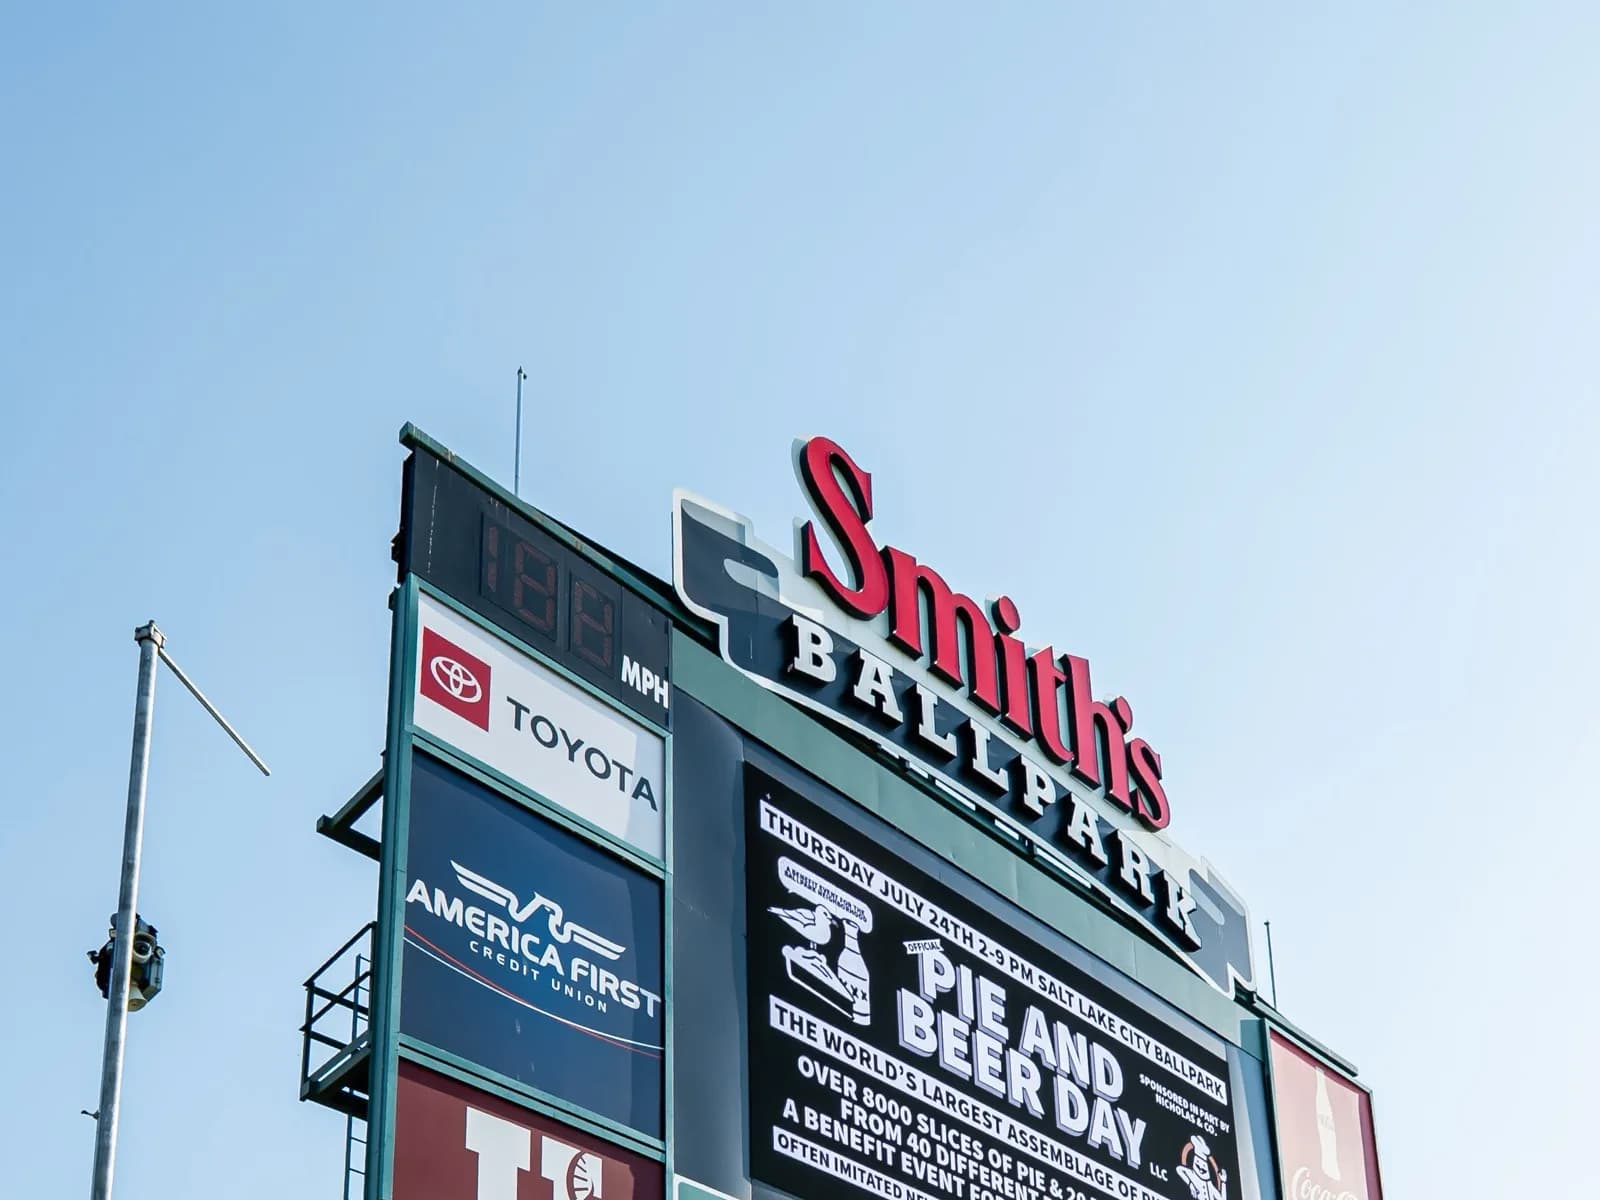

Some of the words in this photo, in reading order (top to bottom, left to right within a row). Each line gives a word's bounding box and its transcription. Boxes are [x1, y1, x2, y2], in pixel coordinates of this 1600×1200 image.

[621, 655, 669, 708] MPH
[800, 436, 1171, 832] Smith's
[506, 696, 657, 812] TOYOTA
[792, 613, 1201, 949] BALLPARK
[406, 879, 565, 976] AMERICA
[571, 957, 662, 1017] FIRST
[469, 940, 540, 981] CREDIT
[551, 978, 607, 1013] UNION
[765, 808, 874, 887] THURSDAY
[880, 879, 923, 917] JULY
[929, 909, 974, 948] 24TH
[978, 939, 1004, 965] 2-9
[1010, 957, 1034, 985] PM
[1038, 977, 1075, 1008] SALT
[1079, 999, 1116, 1034] LAKE
[1120, 1022, 1151, 1053] CITY
[1155, 1042, 1225, 1098] BALLPARK
[908, 942, 940, 952] OFFICIAL
[897, 987, 1045, 1119] BEER
[1053, 1074, 1147, 1169] DAY
[918, 950, 1009, 1044] PIE
[1019, 1005, 1123, 1102] AND
[775, 1004, 818, 1042] THE
[823, 1028, 917, 1090] WORLD'S
[922, 1079, 1003, 1135] LARGEST
[1007, 1124, 1115, 1191] ASSEMBLAGE
[1118, 1183, 1138, 1200] OF
[782, 1098, 799, 1124] A
[804, 1106, 896, 1166] BENEFIT
[901, 1151, 965, 1199] EVENT
[798, 1055, 857, 1100] OVER
[863, 1088, 912, 1126] 8000
[916, 1113, 984, 1161] SLICES
[987, 1147, 1012, 1176] OF
[1017, 1161, 1046, 1191] PIE
[1050, 1178, 1063, 1199] &
[841, 1098, 902, 1146] FROM
[906, 1132, 932, 1159] 40
[1139, 1074, 1188, 1110] SPONSORED
[1200, 1107, 1219, 1126] PART
[1220, 1120, 1230, 1133] BY
[1156, 1095, 1195, 1125] NICHOLAS
[1204, 1121, 1218, 1136] CO.
[778, 1133, 830, 1169] OFTEN
[834, 1157, 902, 1199] IMITATED
[1150, 1162, 1168, 1181] LLC
